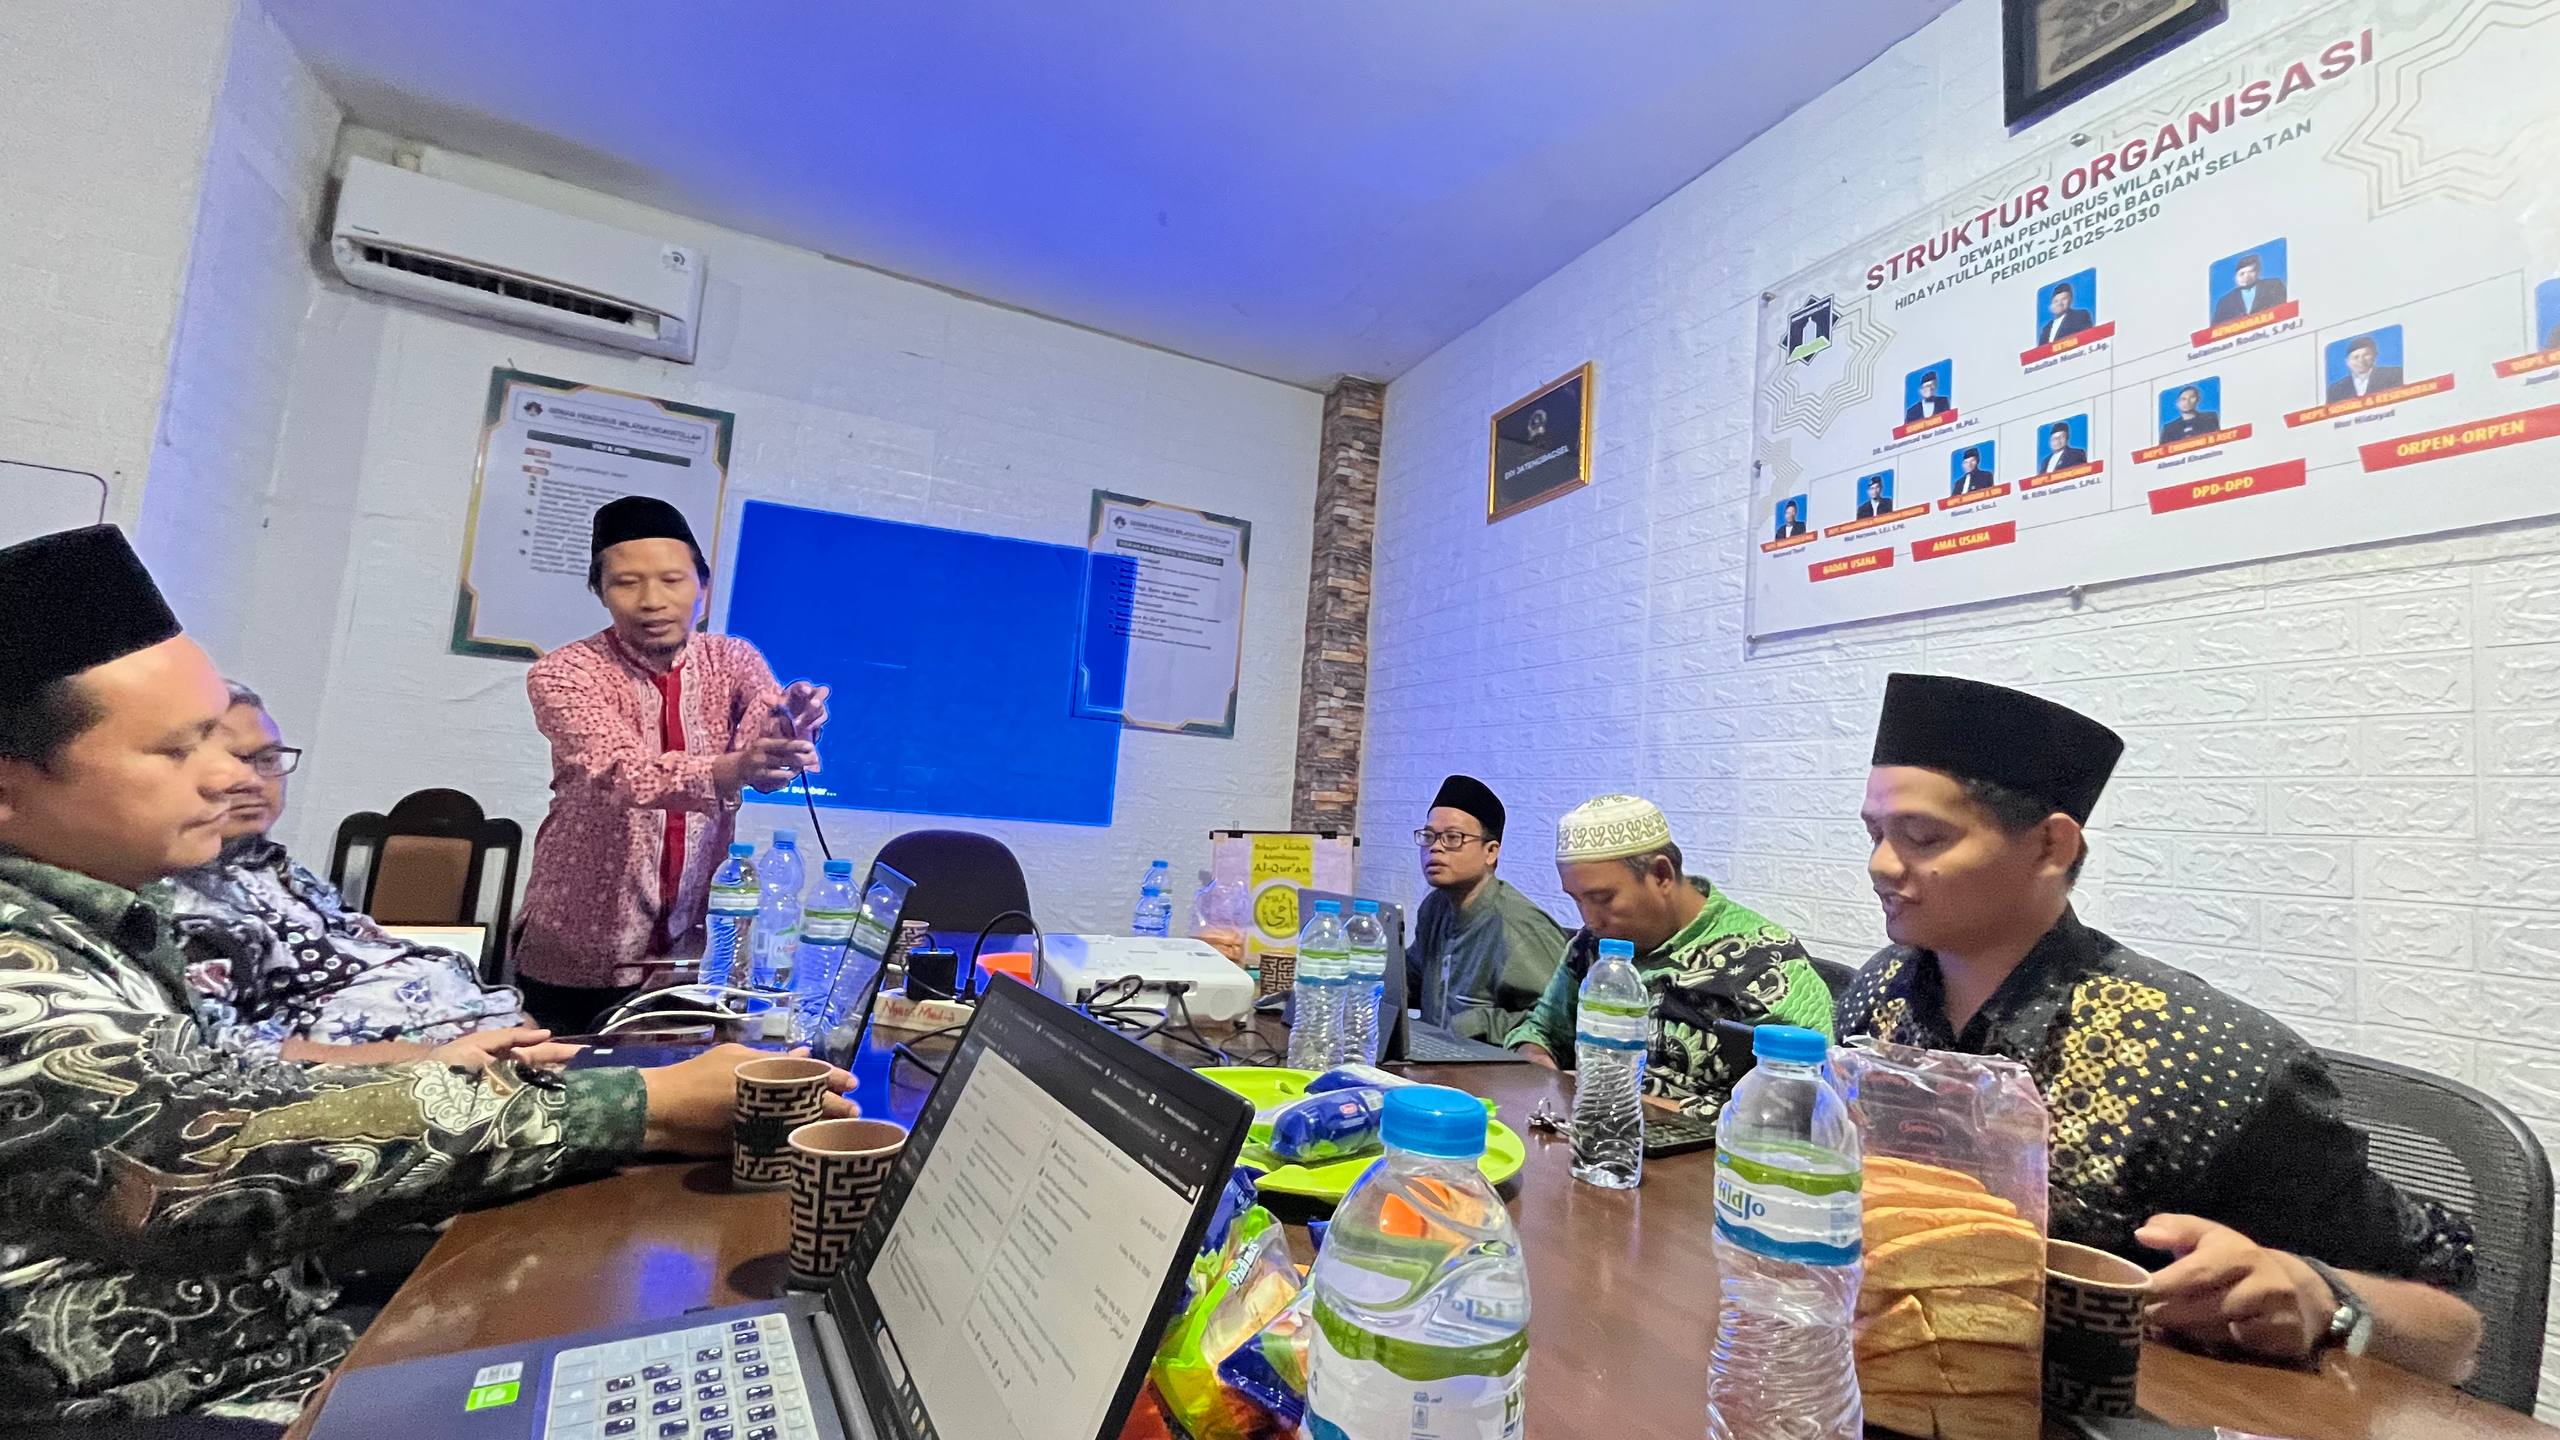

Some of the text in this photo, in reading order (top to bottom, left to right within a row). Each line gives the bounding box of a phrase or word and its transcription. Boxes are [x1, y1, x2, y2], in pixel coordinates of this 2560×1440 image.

[1866, 28, 2374, 291] STRUKTUR ORGANISASI
[1960, 146, 2205, 268] DEWAN PENGURUS WILAYAH
[1895, 254, 2005, 310] HIDAYATULLAH
[2009, 240, 2035, 261] DIY
[2049, 201, 2120, 243] JATENG
[2124, 167, 2200, 212] BAGIAN
[2205, 118, 2311, 176] SELATAN
[1991, 203, 2161, 285] PERIODE 2025-2030
[2192, 476, 2254, 499] DPD-DPD
[2396, 419, 2526, 457] ORPEN-ORPEN
